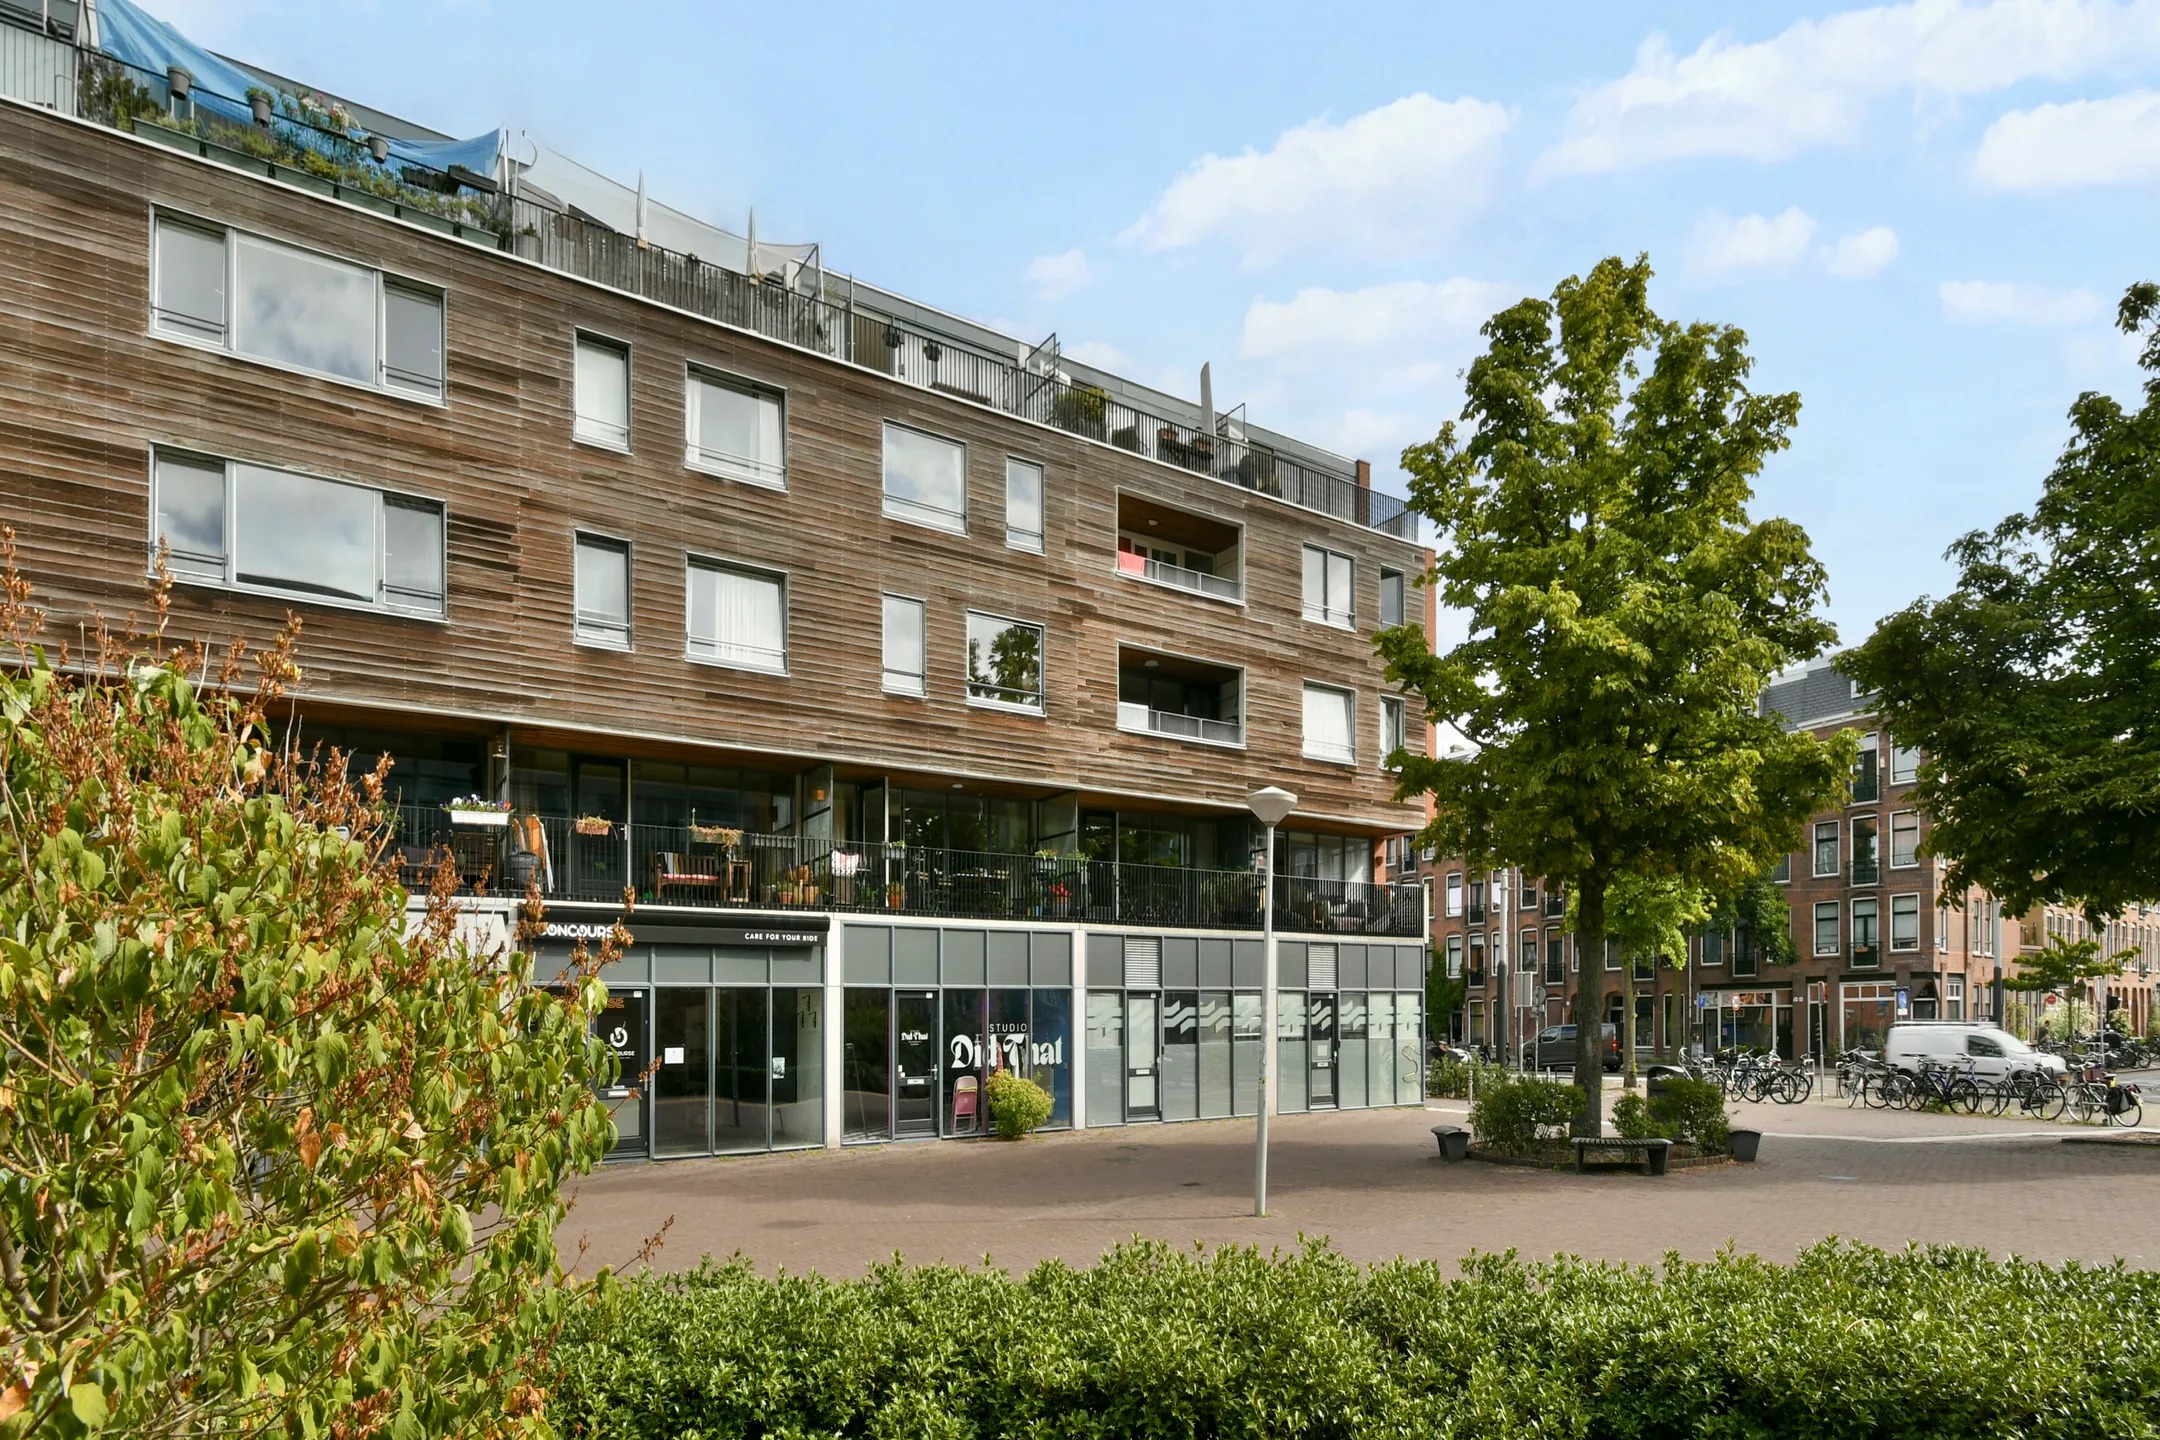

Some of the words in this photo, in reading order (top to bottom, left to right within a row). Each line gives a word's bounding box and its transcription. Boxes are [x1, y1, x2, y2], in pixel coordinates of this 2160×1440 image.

[541, 923, 615, 938] ONCOURS
[744, 932, 764, 940] CARE
[765, 933, 780, 941] FOR
[989, 1023, 1028, 1033] STUDIO
[950, 1034, 998, 1069] Did
[1002, 1034, 1063, 1067] That
